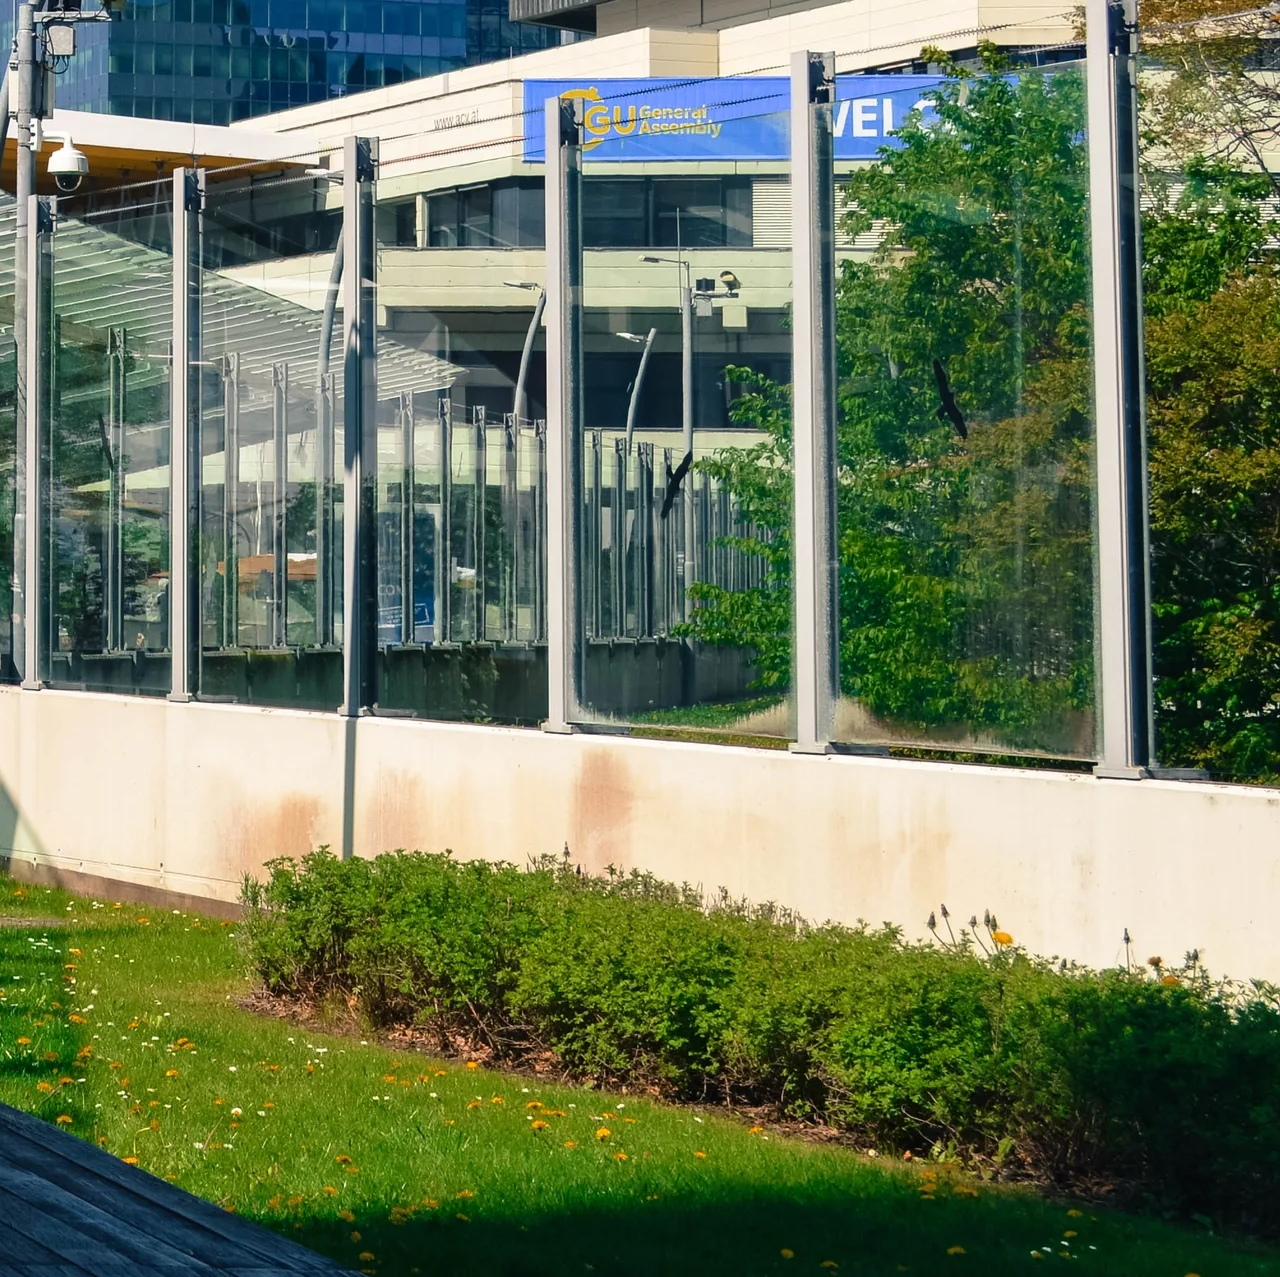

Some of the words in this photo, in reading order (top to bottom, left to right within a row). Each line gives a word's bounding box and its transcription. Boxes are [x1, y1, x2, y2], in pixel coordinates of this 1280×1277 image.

[584, 105, 637, 135] GU
[639, 104, 708, 120] General
[639, 119, 722, 138] Assembly
